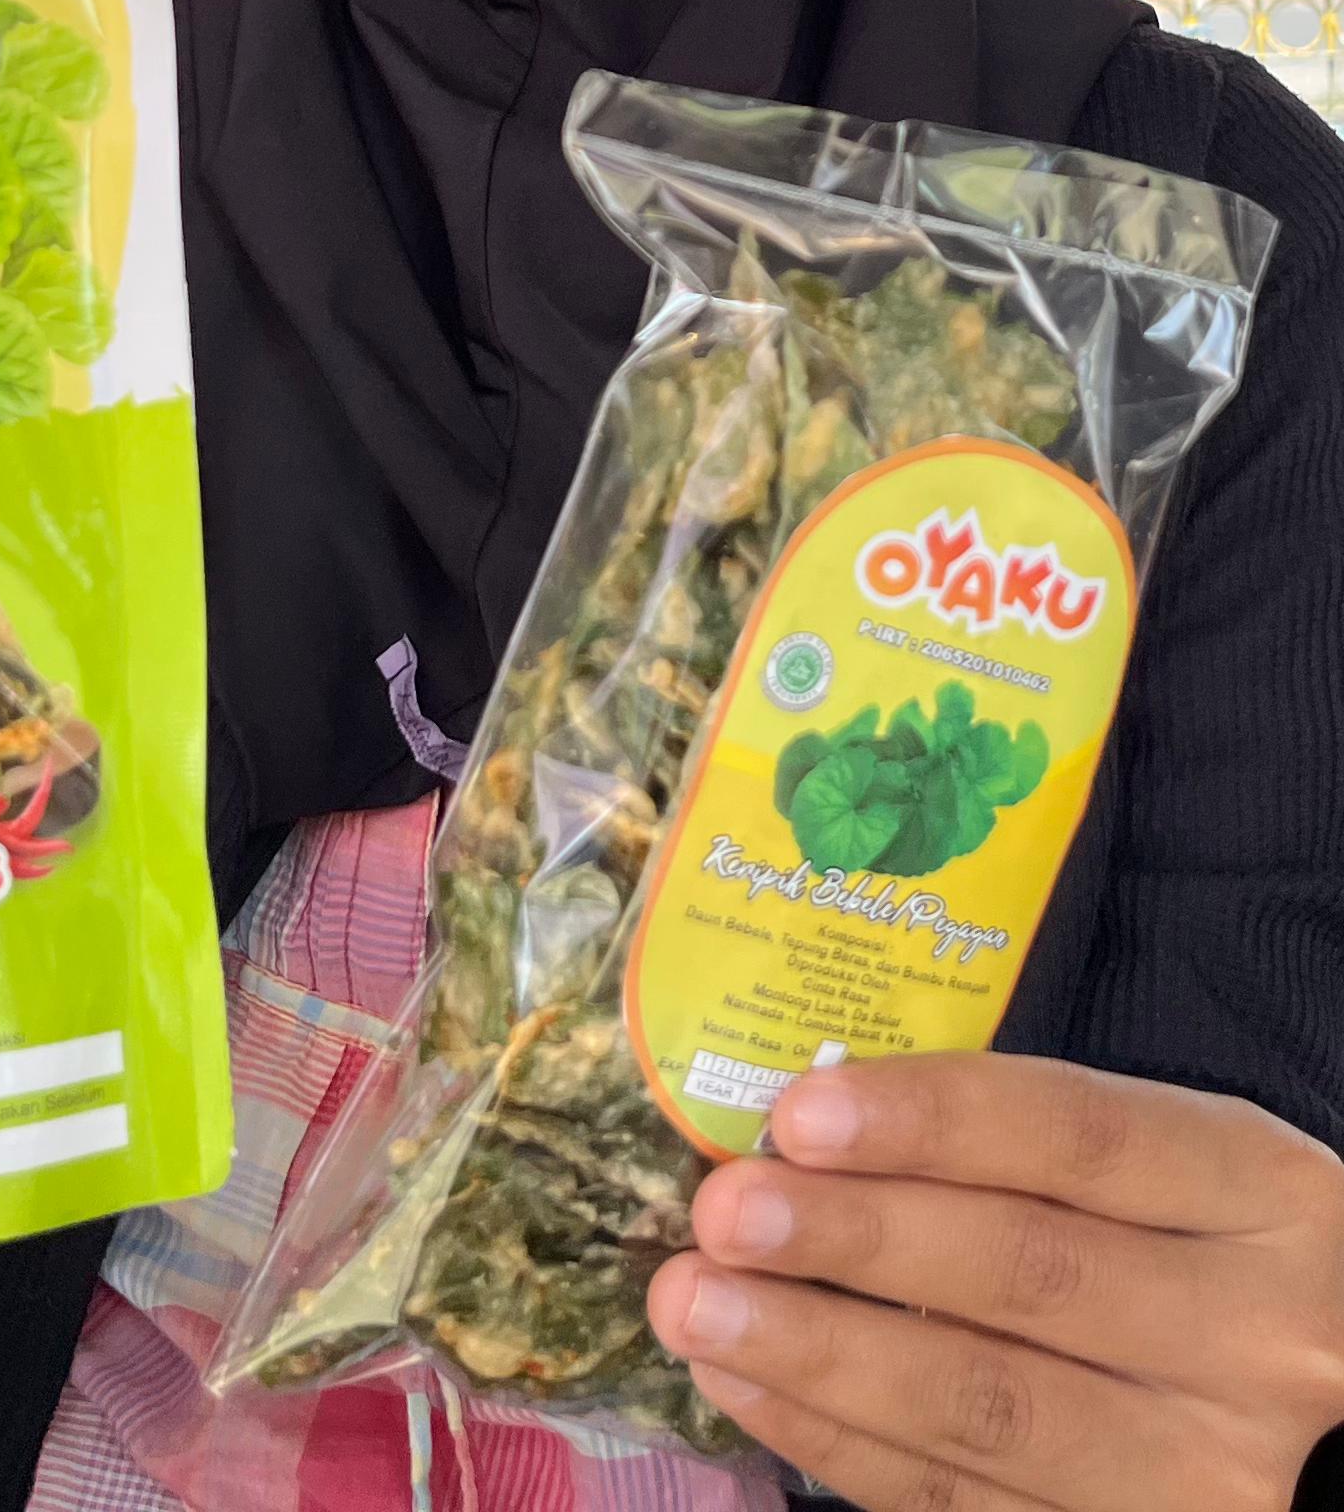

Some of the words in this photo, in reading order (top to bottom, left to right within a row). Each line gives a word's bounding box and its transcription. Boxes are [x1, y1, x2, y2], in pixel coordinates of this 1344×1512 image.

[859, 513, 1103, 636] OYAKU
[858, 619, 907, 647] P-IRT
[703, 834, 813, 901] Keripik
[875, 959, 900, 974] dan
[839, 987, 872, 1005] Rasa
[722, 992, 785, 1021] Narmada
[795, 1013, 847, 1036] Lombok
[701, 1016, 745, 1042] Varian
[748, 1031, 782, 1052] Rasa
[717, 1061, 729, 1077] 2
[736, 1064, 748, 1079] 3
[772, 1072, 783, 1086] 5
[695, 1077, 734, 1100] YEAR
